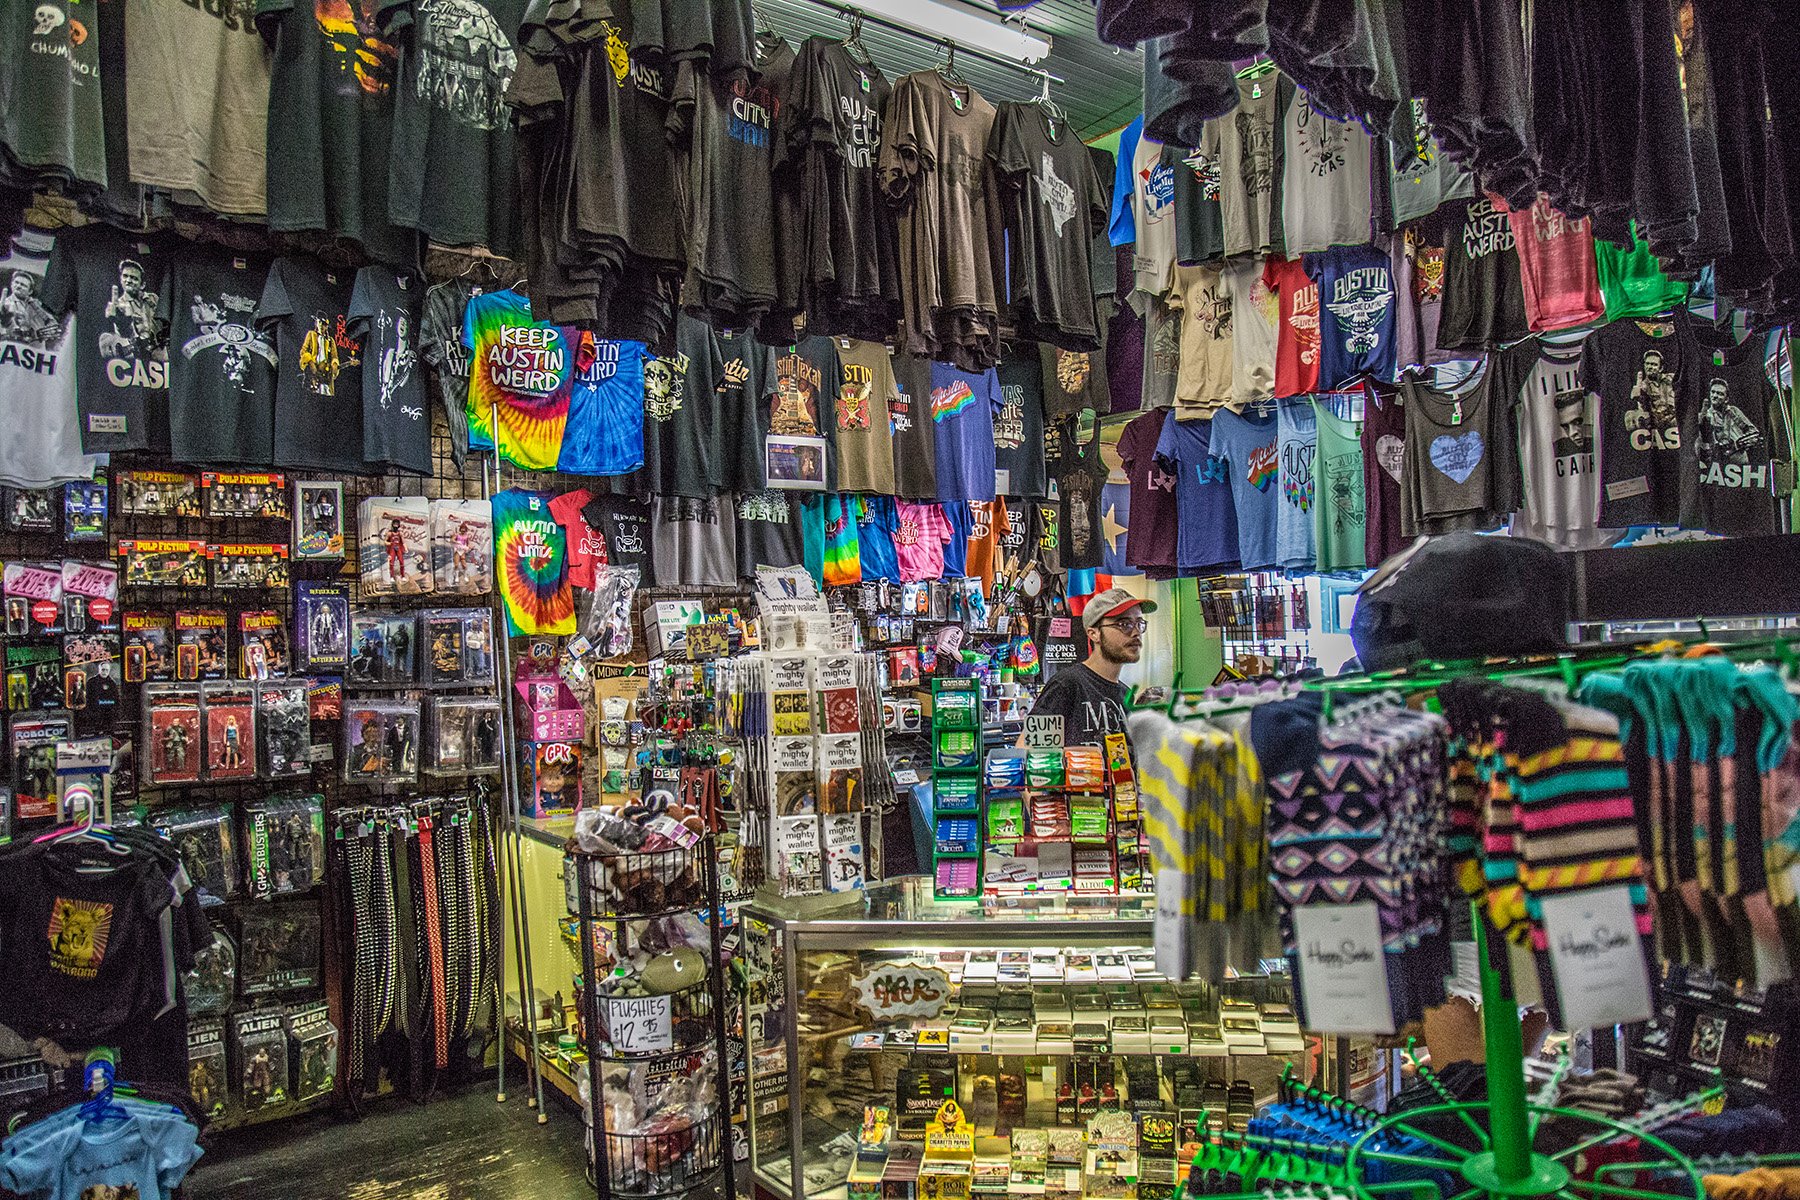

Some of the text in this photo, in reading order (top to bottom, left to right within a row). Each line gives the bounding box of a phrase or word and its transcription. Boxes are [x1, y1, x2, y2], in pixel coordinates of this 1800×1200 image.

[732, 97, 771, 129] CITY
[1463, 213, 1510, 243] AUSTI
[1466, 232, 1515, 259] WEIRD
[1334, 267, 1389, 302] AUSTIN
[500, 324, 559, 349] KEEP
[594, 342, 621, 361] TIN
[0, 344, 57, 375] ASH
[488, 347, 564, 371] AUSTIN
[1154, 354, 1180, 374] TEX
[723, 358, 750, 380] stin
[844, 363, 873, 384] STIN
[491, 368, 561, 393] WEIRD
[931, 381, 969, 408] Austin
[993, 420, 1024, 441] EER
[1630, 427, 1681, 451] CAS
[1284, 445, 1316, 486] AUST
[133, 472, 185, 484] PULP FICTION
[219, 473, 270, 485] PULP FICTION
[738, 505, 789, 524] austin
[1007, 511, 1023, 522] EEP
[514, 521, 557, 535] AUSTIN
[523, 532, 547, 545] CITY
[137, 541, 192, 553] PULP FICTION
[224, 545, 274, 557] PULP FICTION
[518, 545, 553, 559] LIMITS
[772, 602, 818, 614] mighty wallet
[127, 617, 145, 628] PULP
[179, 615, 226, 627] PULP FICTION
[245, 616, 261, 628] PULP
[707, 614, 729, 623] Advil
[533, 643, 553, 659] GPK
[597, 666, 649, 679] MONEY TAL
[776, 671, 805, 680] mighty
[822, 669, 851, 679] mighty
[778, 680, 804, 688] wallet
[824, 678, 851, 687] wallet
[1026, 717, 1063, 732] GUM!
[1025, 734, 1061, 747] $1.50
[546, 746, 571, 763] GPK
[781, 751, 809, 760] mighty
[828, 749, 857, 758] mighty
[782, 759, 808, 768] wallet
[830, 758, 856, 766] wallet
[786, 831, 815, 840] mighty
[828, 826, 858, 835] mighty
[788, 840, 814, 849] wallet
[831, 836, 857, 844] wallet
[611, 998, 666, 1018] PLUSHIES
[241, 1018, 280, 1034] ALIEN
[291, 1012, 327, 1029] ALIEN
[188, 1030, 219, 1045] LIEN
[755, 1078, 777, 1090] OTHER
[766, 1084, 788, 1095] DAUGHT
[944, 1181, 965, 1190] BOB
